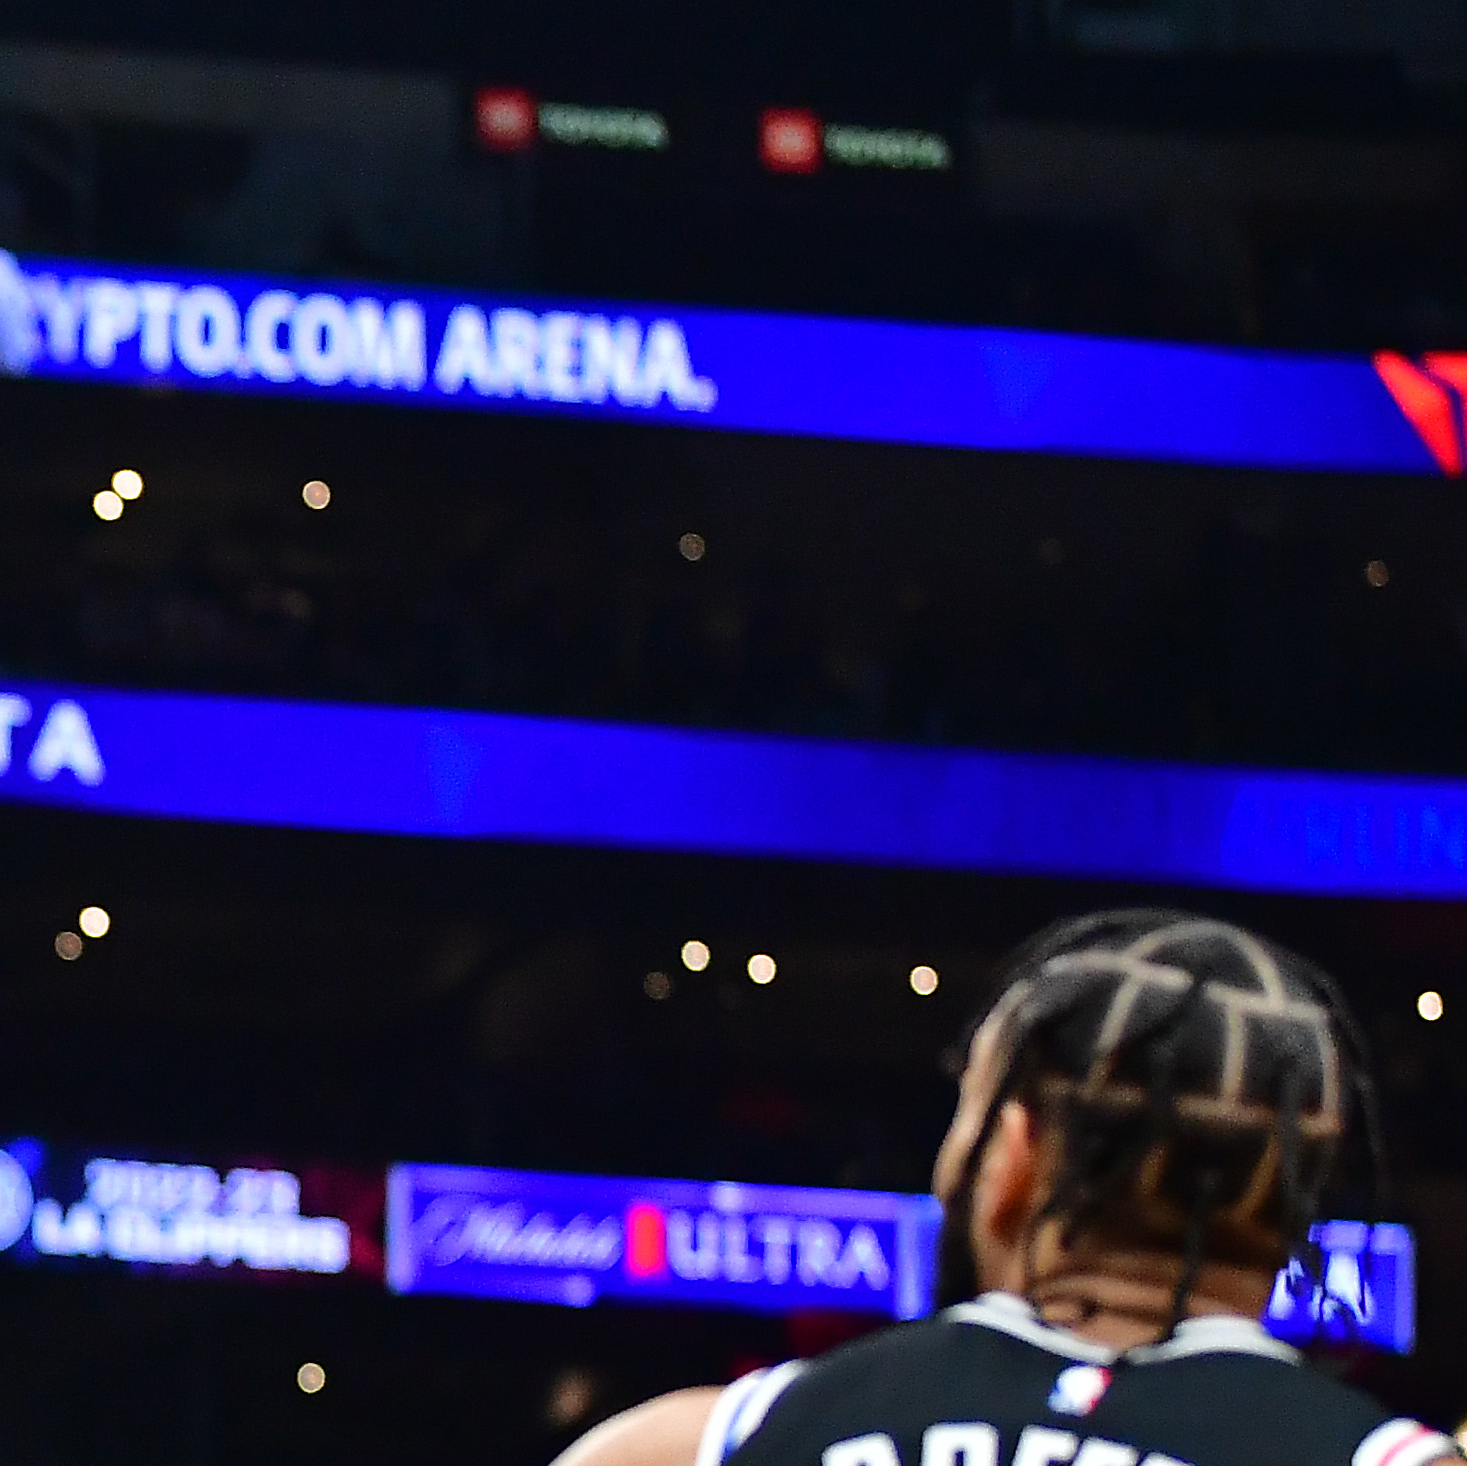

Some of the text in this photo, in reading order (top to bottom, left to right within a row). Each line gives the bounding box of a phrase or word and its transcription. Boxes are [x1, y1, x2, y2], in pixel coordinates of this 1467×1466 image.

[12, 272, 426, 391] YPTO.COM
[434, 302, 719, 413] ARENA.
[668, 1208, 892, 1292] ULTRA
